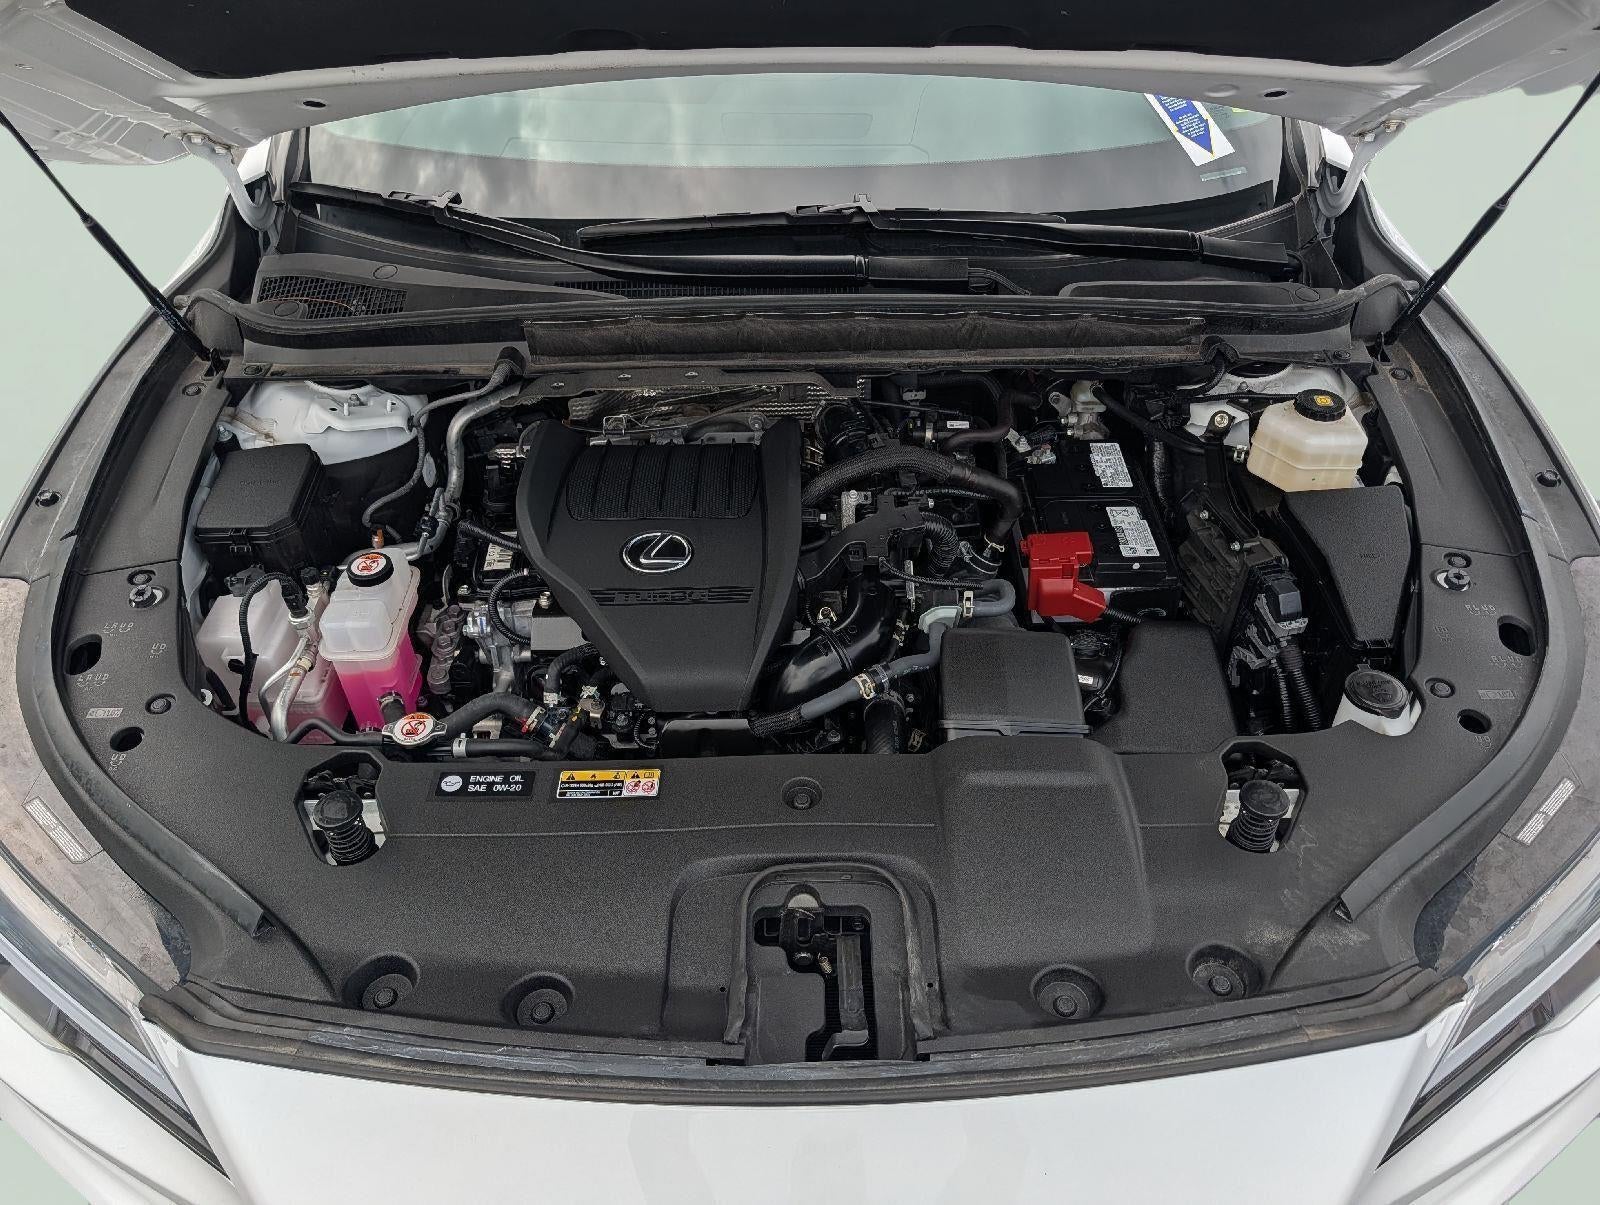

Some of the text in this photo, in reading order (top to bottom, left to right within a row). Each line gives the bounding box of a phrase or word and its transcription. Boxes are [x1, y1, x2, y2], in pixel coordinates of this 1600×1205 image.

[469, 774, 525, 783] ENGINE OIL
[467, 784, 522, 792] SAE 0W-20
